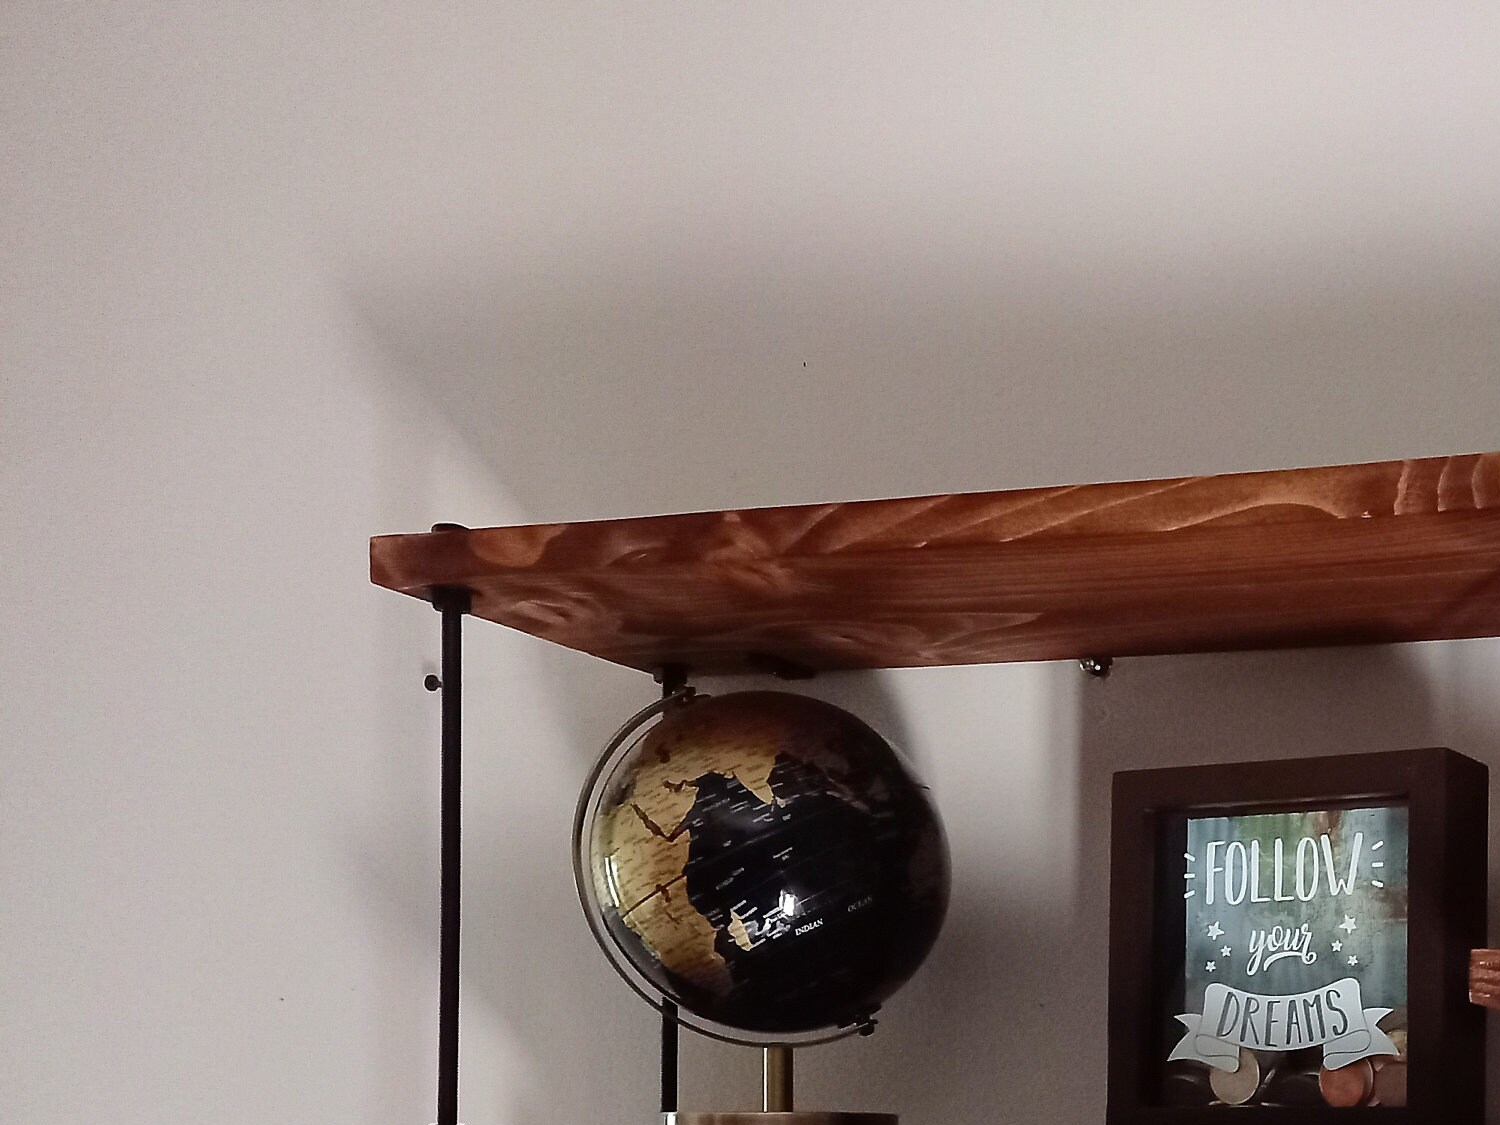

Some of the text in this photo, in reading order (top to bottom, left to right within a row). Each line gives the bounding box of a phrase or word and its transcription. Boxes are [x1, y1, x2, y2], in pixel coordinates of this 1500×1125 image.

[1205, 831, 1365, 906] FOLLOW
[794, 917, 824, 936] INDIAN
[1246, 921, 1317, 976] your
[1216, 988, 1349, 1048] DREAMS
